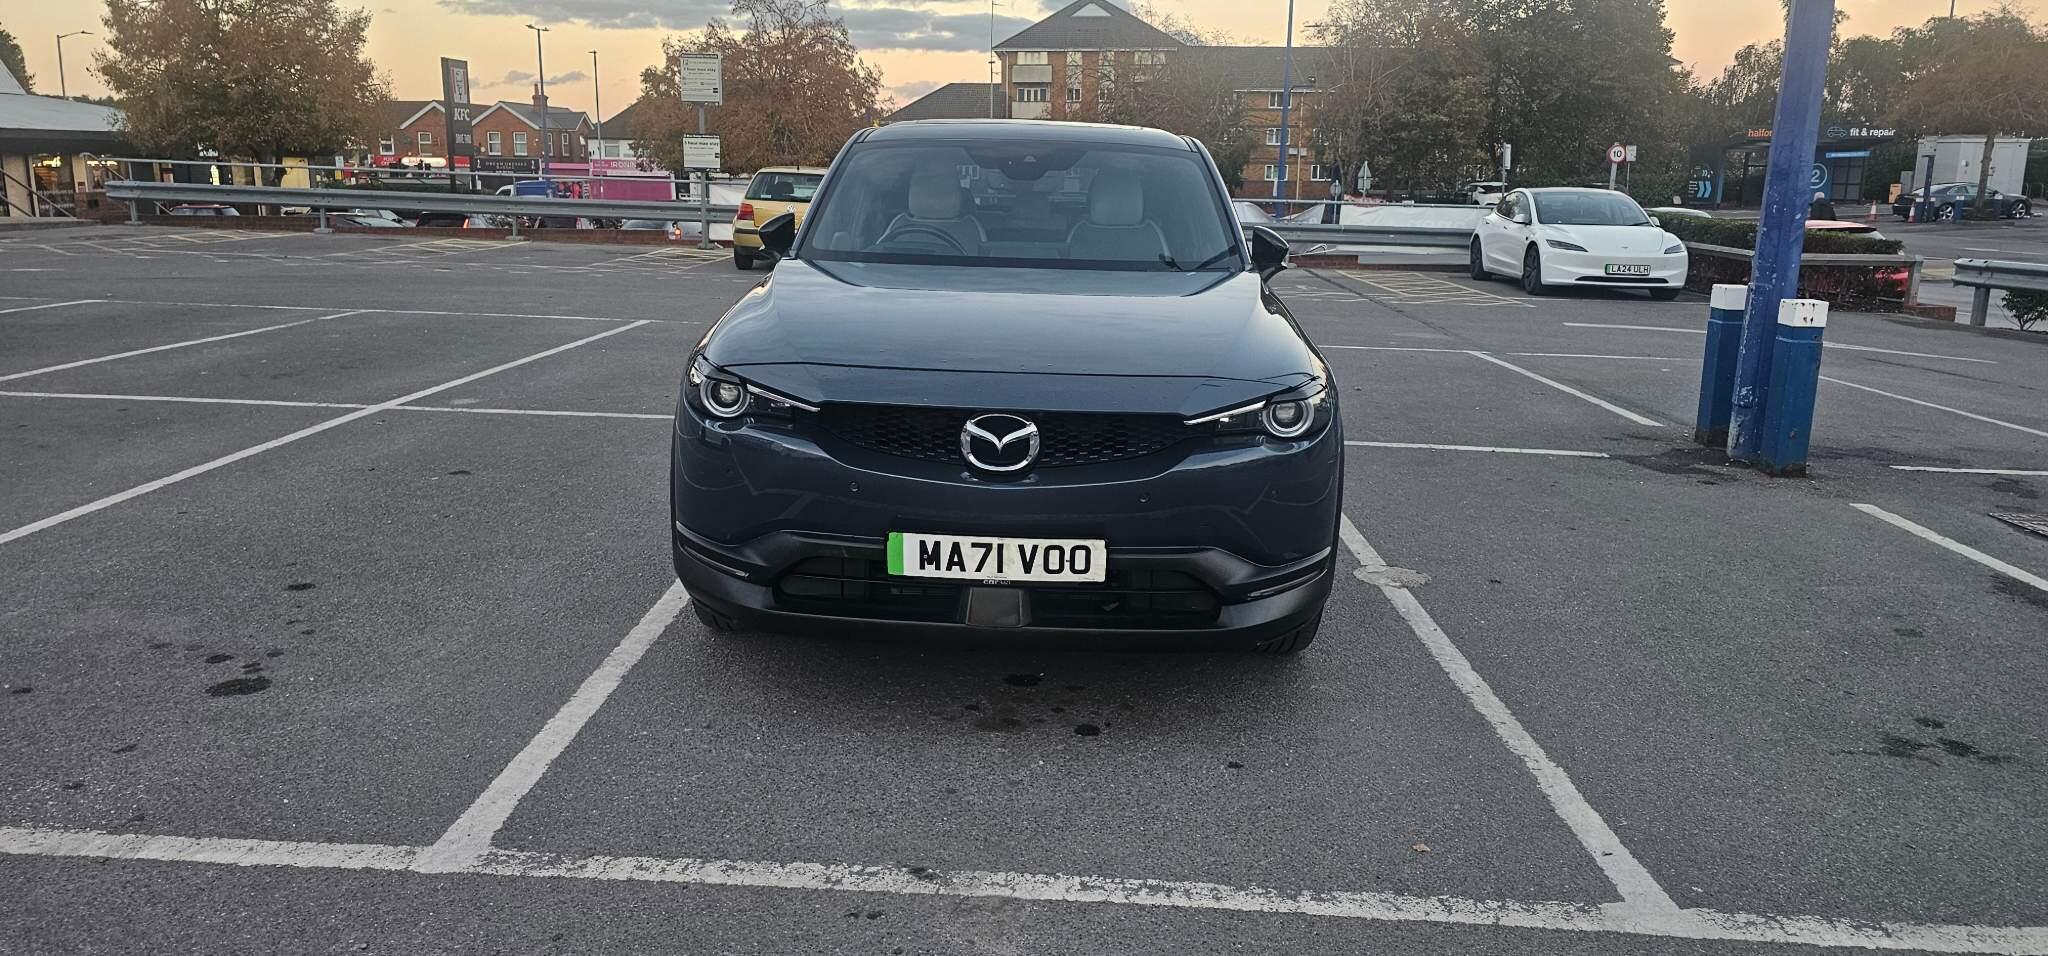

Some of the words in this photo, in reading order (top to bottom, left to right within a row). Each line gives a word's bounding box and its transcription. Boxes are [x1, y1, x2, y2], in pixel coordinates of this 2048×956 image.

[454, 108, 470, 120] KFC
[1748, 128, 1773, 137] halfor
[1850, 128, 1860, 136] fit
[1861, 128, 1868, 136] &
[1869, 128, 1896, 138] repair
[1613, 150, 1622, 158] 10
[1811, 170, 1820, 182] 2
[1633, 265, 1649, 273] ULH
[919, 540, 1004, 574] MA71
[1018, 543, 1092, 575] VOO
